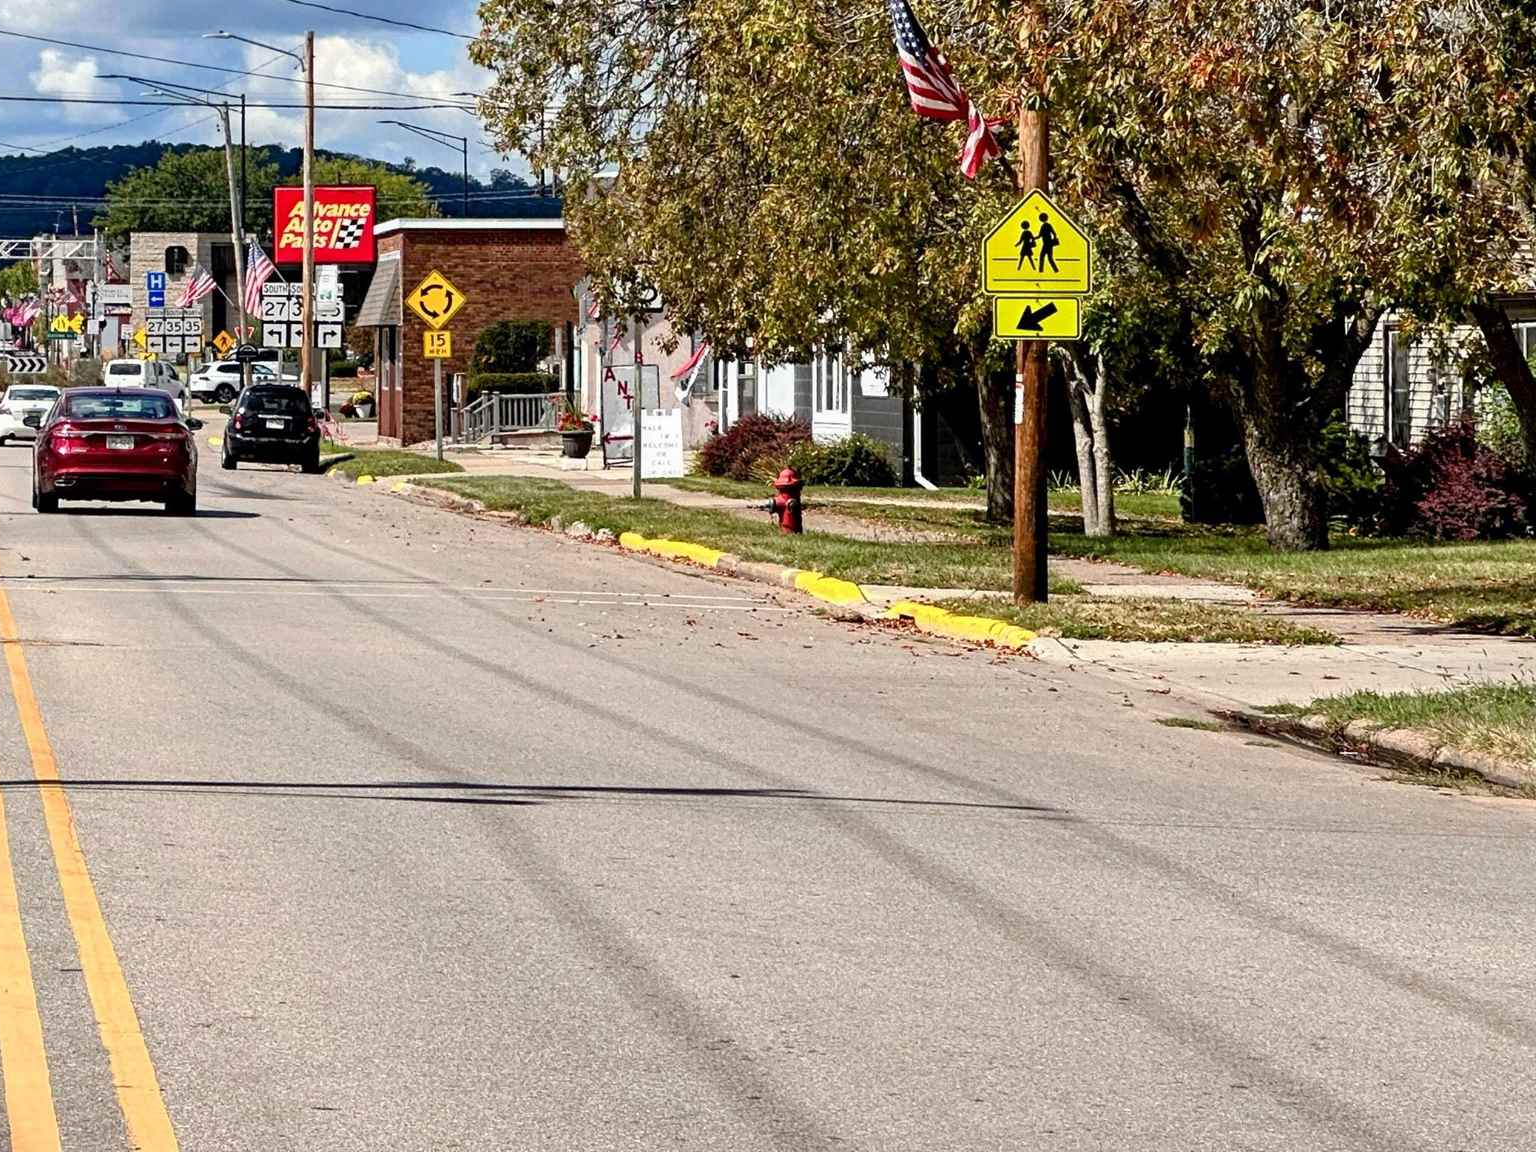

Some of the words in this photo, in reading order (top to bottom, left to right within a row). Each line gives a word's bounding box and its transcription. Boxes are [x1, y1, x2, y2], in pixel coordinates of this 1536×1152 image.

[279, 233, 328, 249] Pats
[150, 274, 163, 289] H
[264, 284, 287, 294] SOUTH
[265, 301, 286, 317] 27
[293, 301, 303, 317] 3
[148, 321, 163, 332] 27
[166, 321, 181, 333] 35
[185, 320, 201, 332] 35
[430, 333, 445, 347] 15
